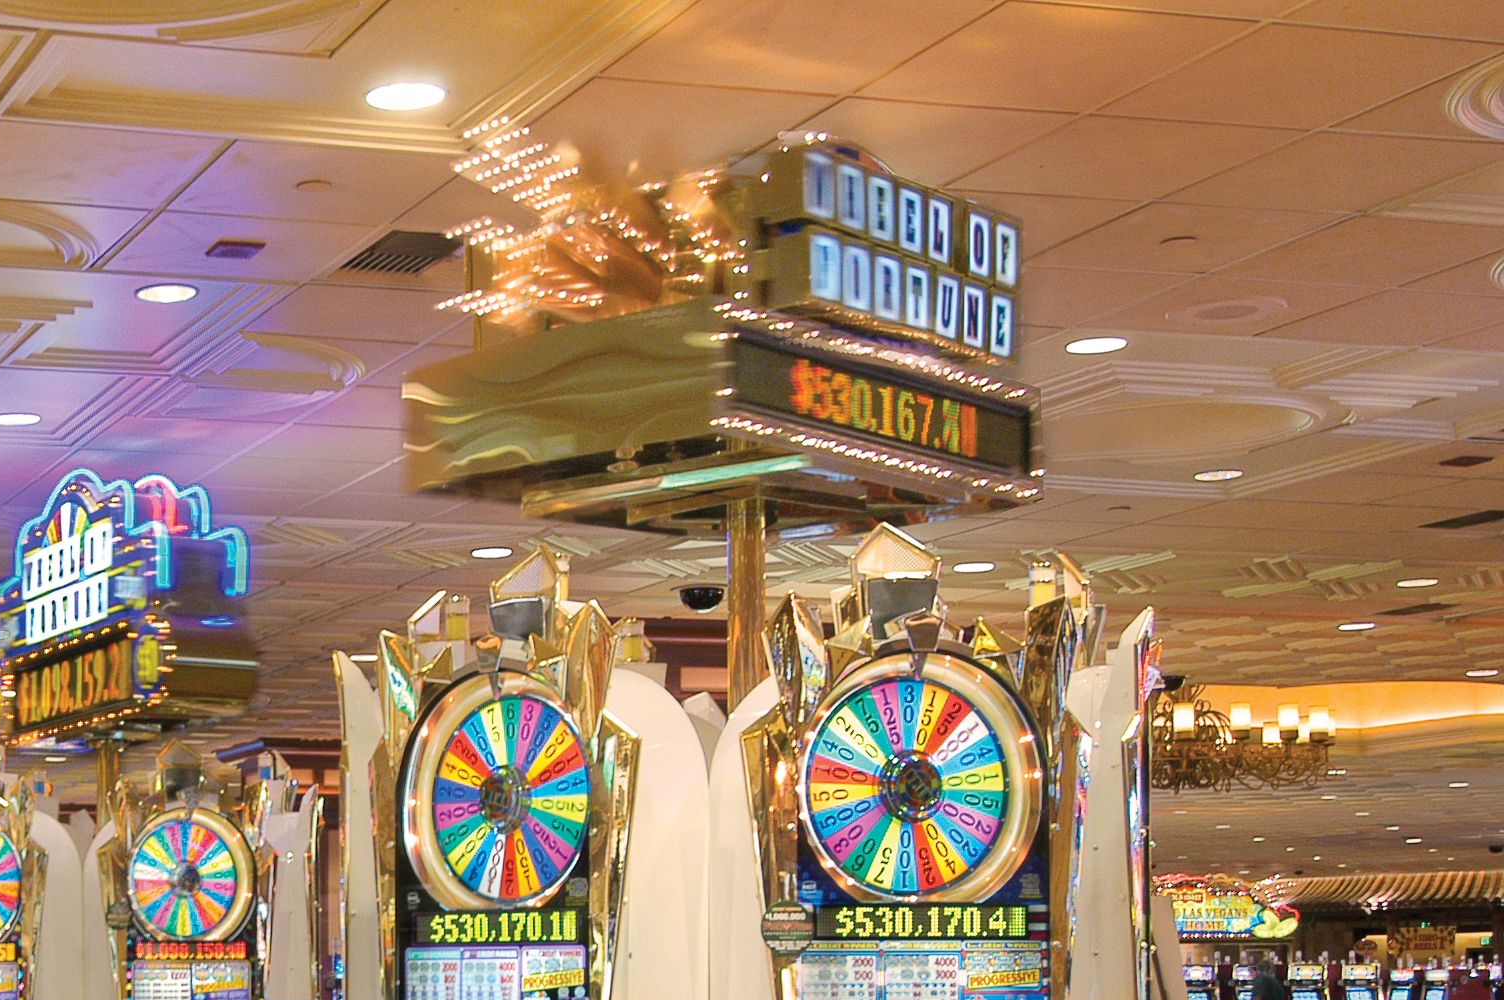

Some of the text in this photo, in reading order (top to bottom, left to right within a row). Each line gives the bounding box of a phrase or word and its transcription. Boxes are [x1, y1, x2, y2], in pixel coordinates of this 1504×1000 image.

[904, 685, 914, 723] 30
[506, 703, 515, 739] 60
[520, 704, 533, 740] 30
[855, 698, 879, 735] 75
[916, 691, 936, 745] 150
[937, 703, 961, 736] 25
[822, 740, 854, 762] 40
[961, 747, 993, 766] 40
[816, 766, 867, 783] 100
[947, 772, 998, 787] 100
[814, 789, 848, 801] 50
[964, 794, 999, 810] 50
[439, 803, 480, 822] 200
[820, 800, 871, 830] 500
[833, 824, 863, 854] 30
[949, 828, 977, 858] 20
[851, 838, 875, 872] 60
[900, 829, 911, 887] 100
[1185, 921, 1224, 931] HOME
[852, 958, 873, 967] 2000
[934, 957, 956, 966] 4000
[523, 970, 584, 989] PROGRESSIVE
[854, 971, 873, 980] 1500
[970, 971, 1038, 986] PROGRESSIVE
